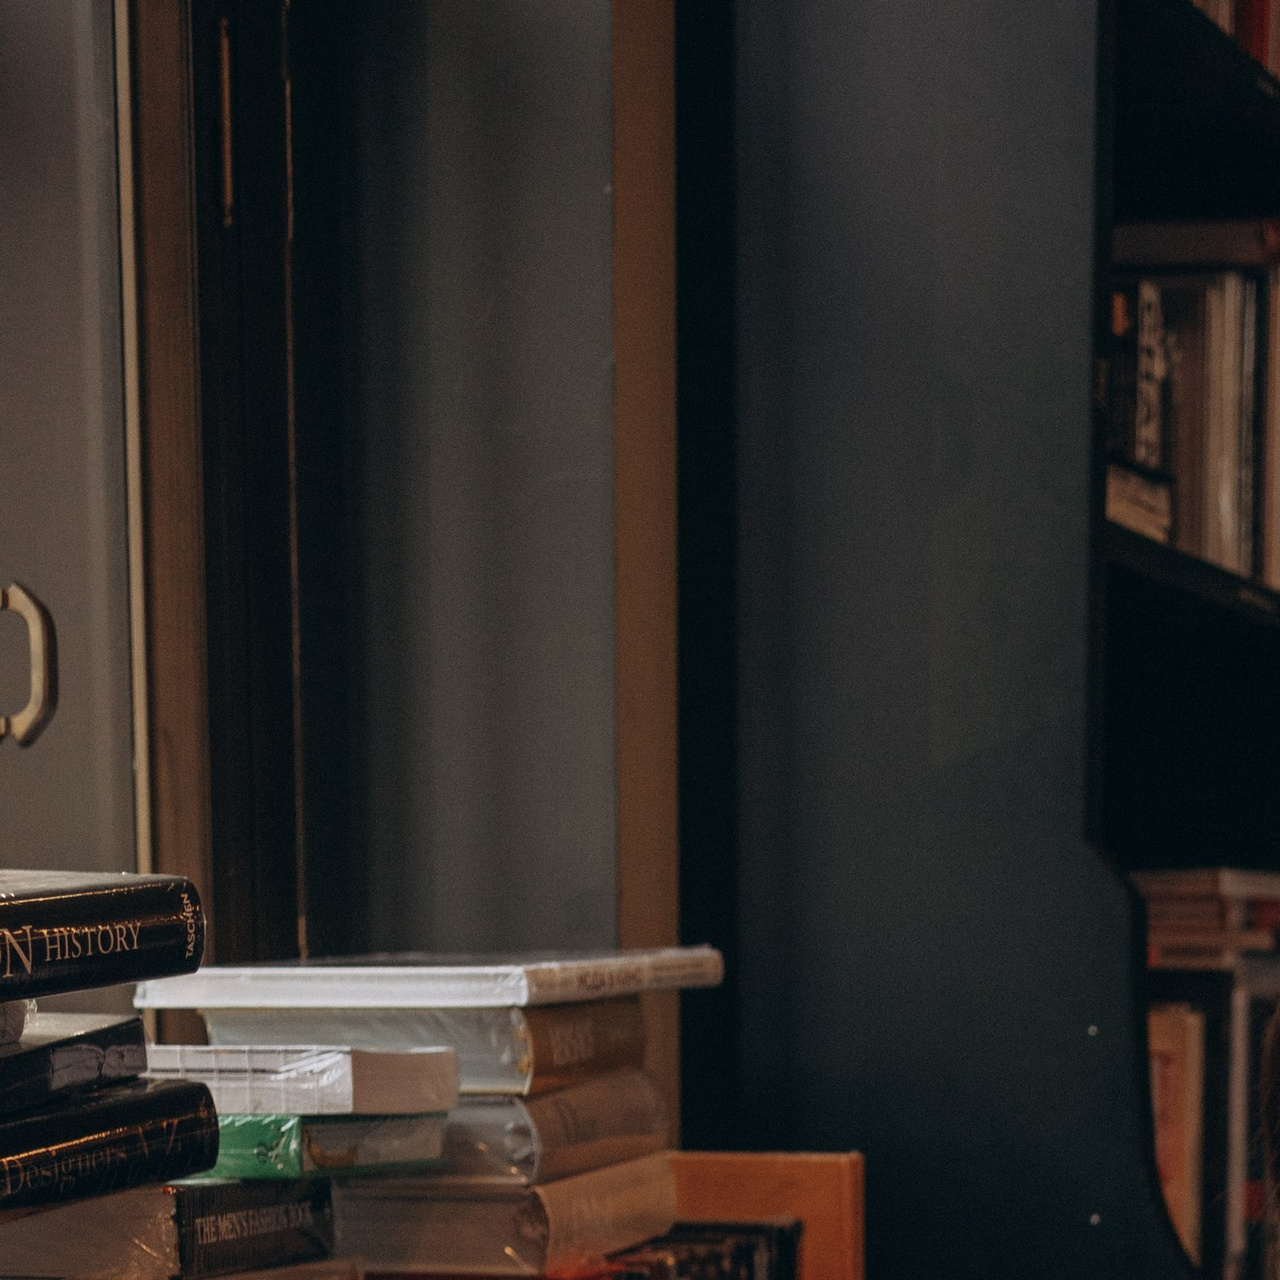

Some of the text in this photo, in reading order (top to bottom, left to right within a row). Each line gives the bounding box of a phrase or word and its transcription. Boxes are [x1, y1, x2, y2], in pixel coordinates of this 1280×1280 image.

[0, 921, 142, 979] N HISTORY
[180, 893, 195, 959] TASCHEN
[2, 1144, 127, 1196] Designers
[195, 1214, 217, 1245] THE
